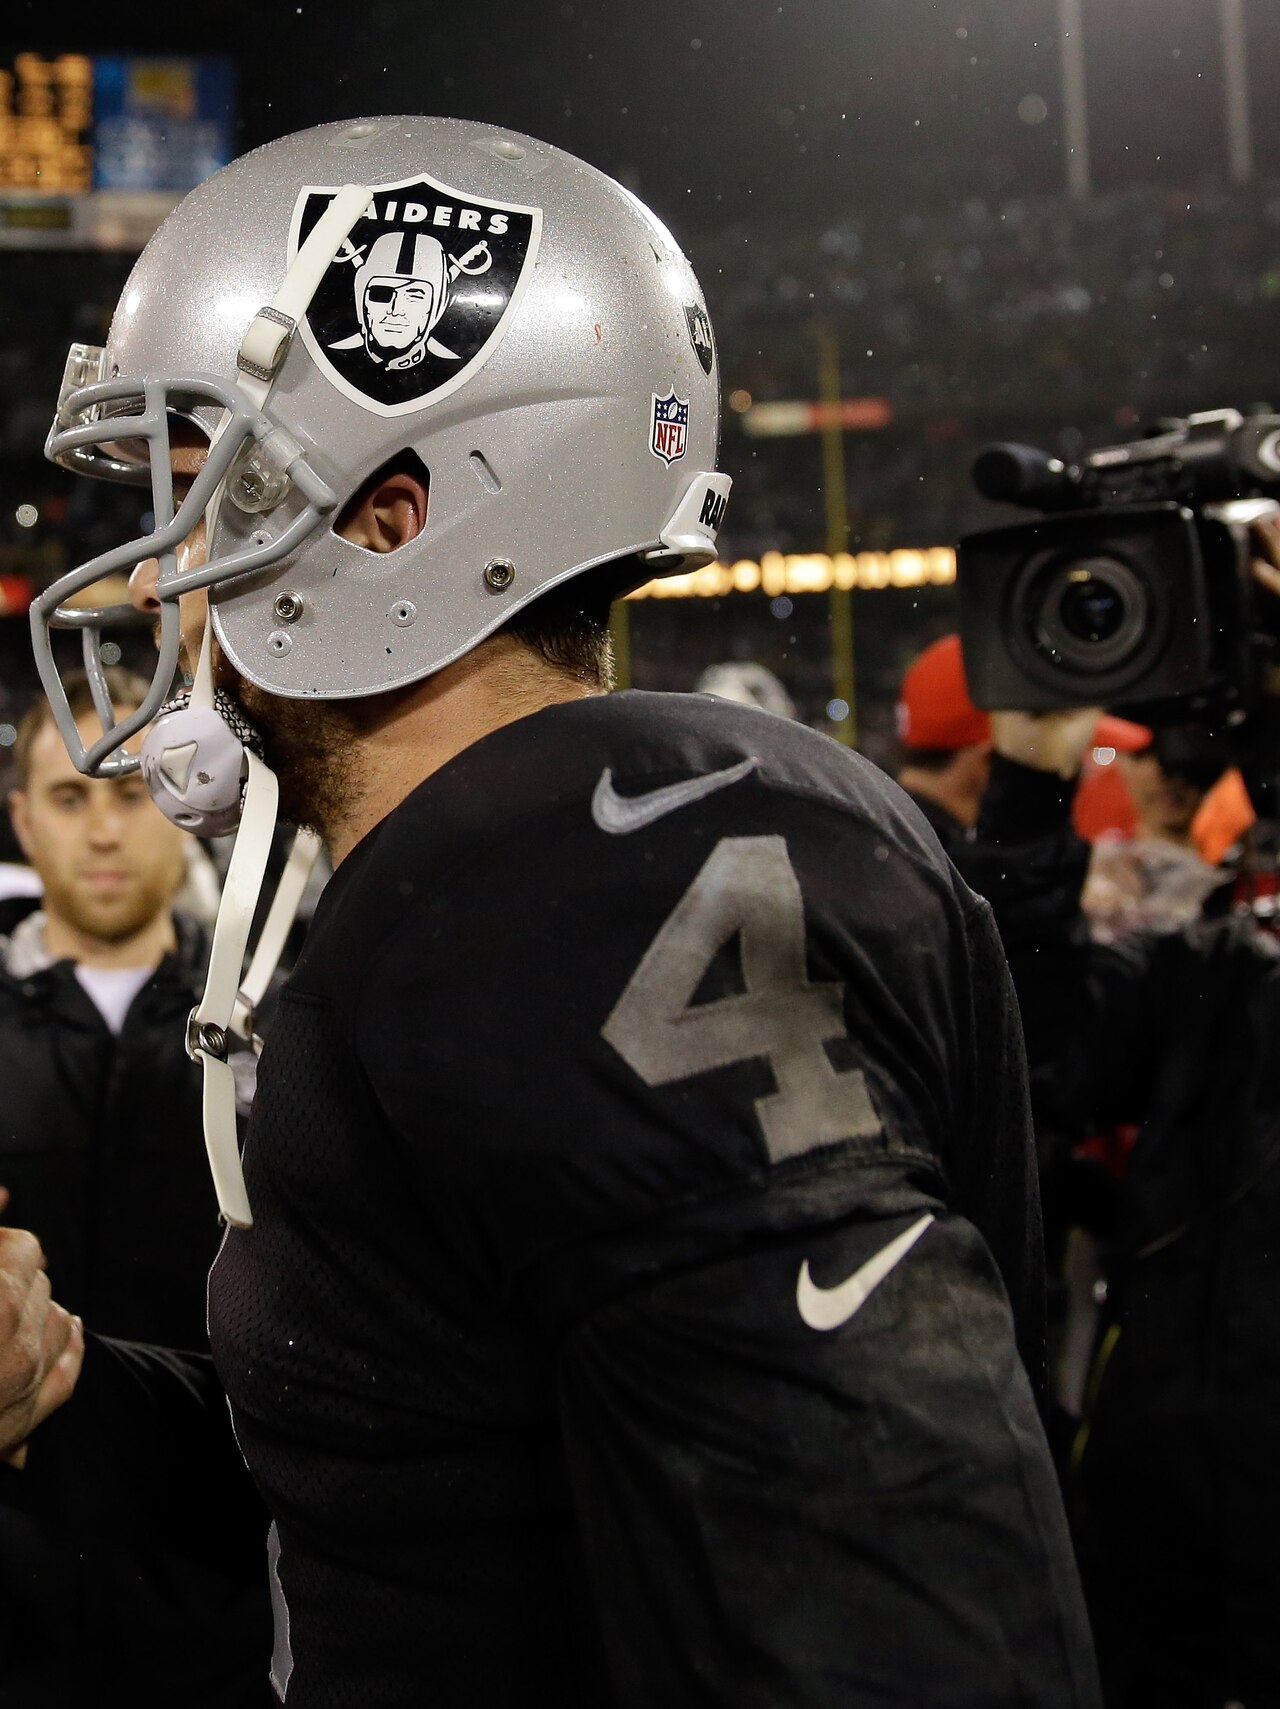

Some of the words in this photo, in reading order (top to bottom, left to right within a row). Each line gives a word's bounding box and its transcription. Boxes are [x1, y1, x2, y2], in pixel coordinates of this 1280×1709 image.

[328, 199, 509, 235] AIDERS
[655, 422, 684, 457] NFL
[600, 834, 883, 1165] 4
